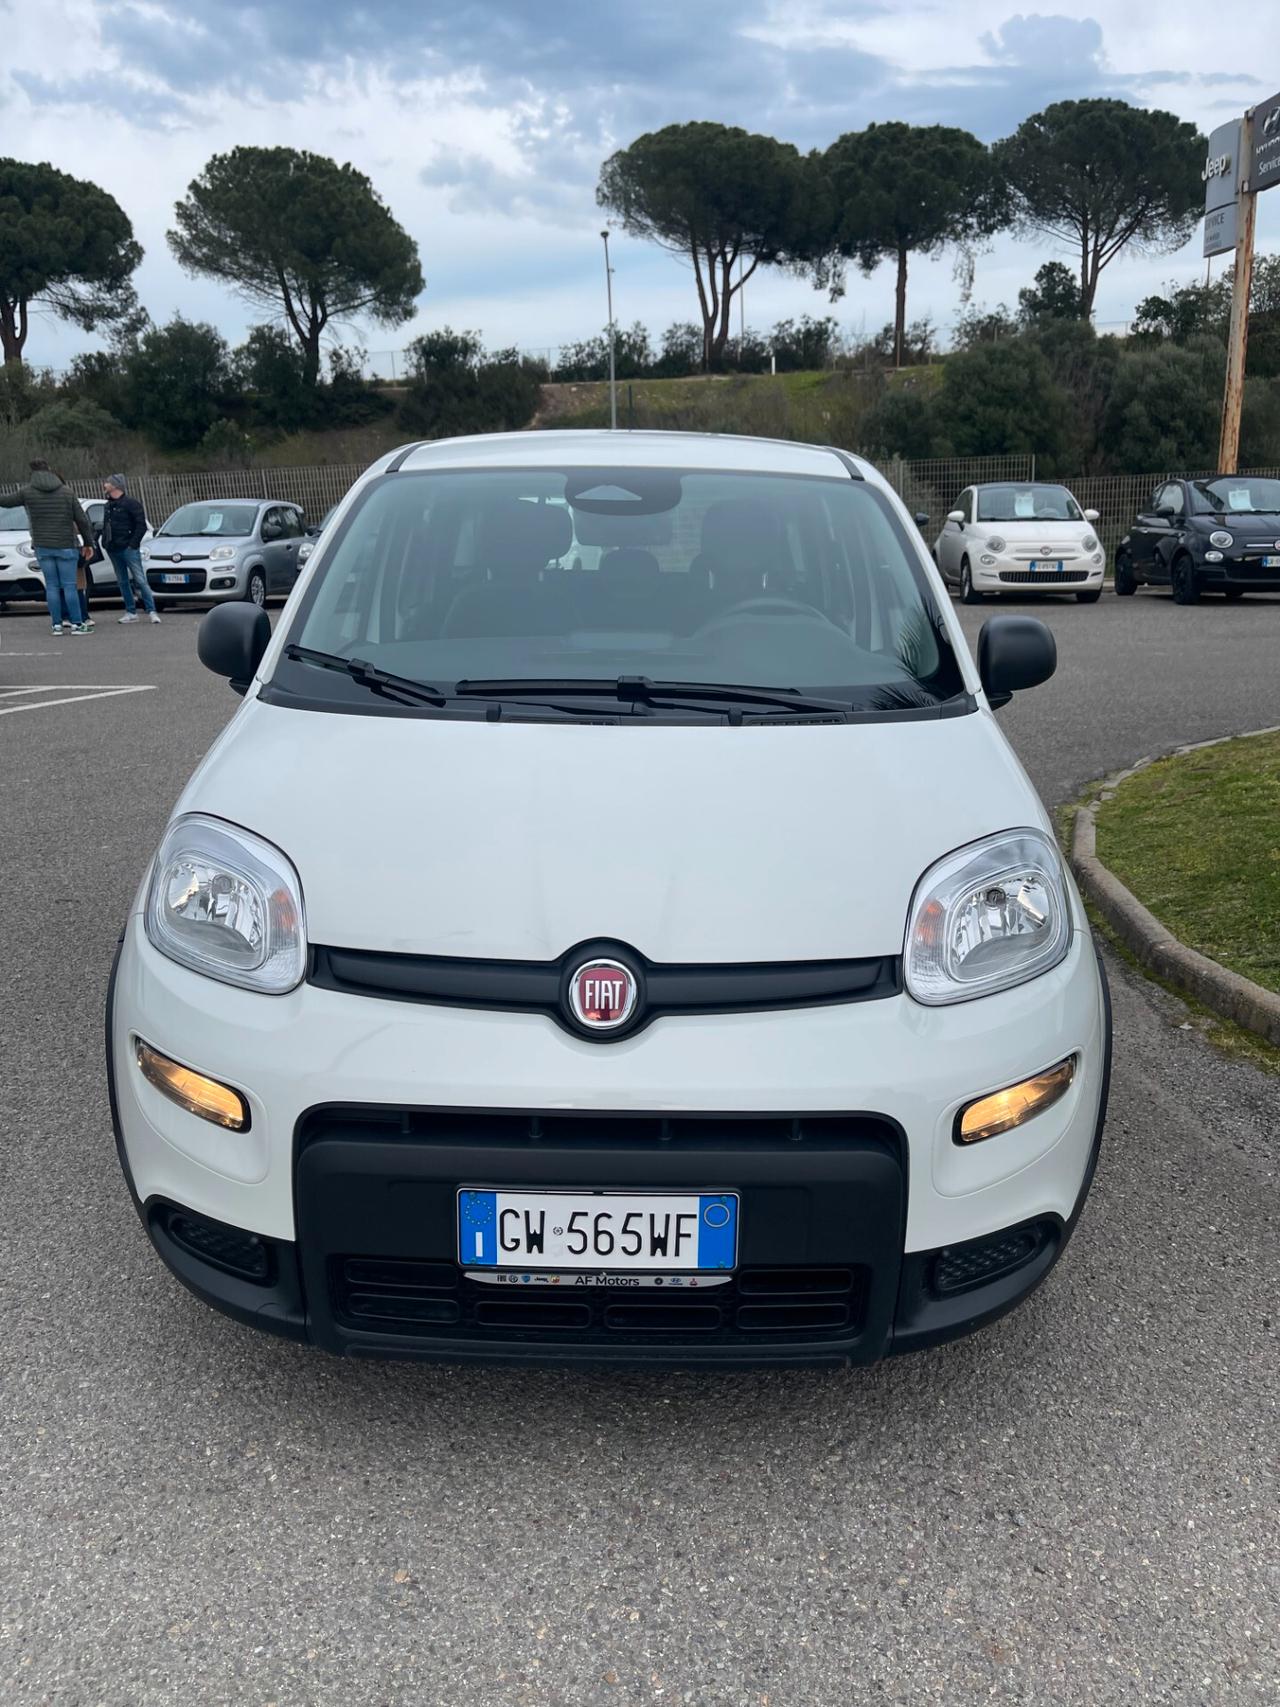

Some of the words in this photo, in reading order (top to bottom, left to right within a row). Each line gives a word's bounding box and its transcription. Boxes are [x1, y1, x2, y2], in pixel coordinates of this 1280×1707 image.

[1201, 155, 1227, 181] Jeep
[585, 980, 624, 1010] FIAT
[499, 1208, 546, 1254] GW
[567, 1211, 698, 1257] 565WF
[575, 1276, 593, 1286] AF
[596, 1276, 640, 1287] Motors
